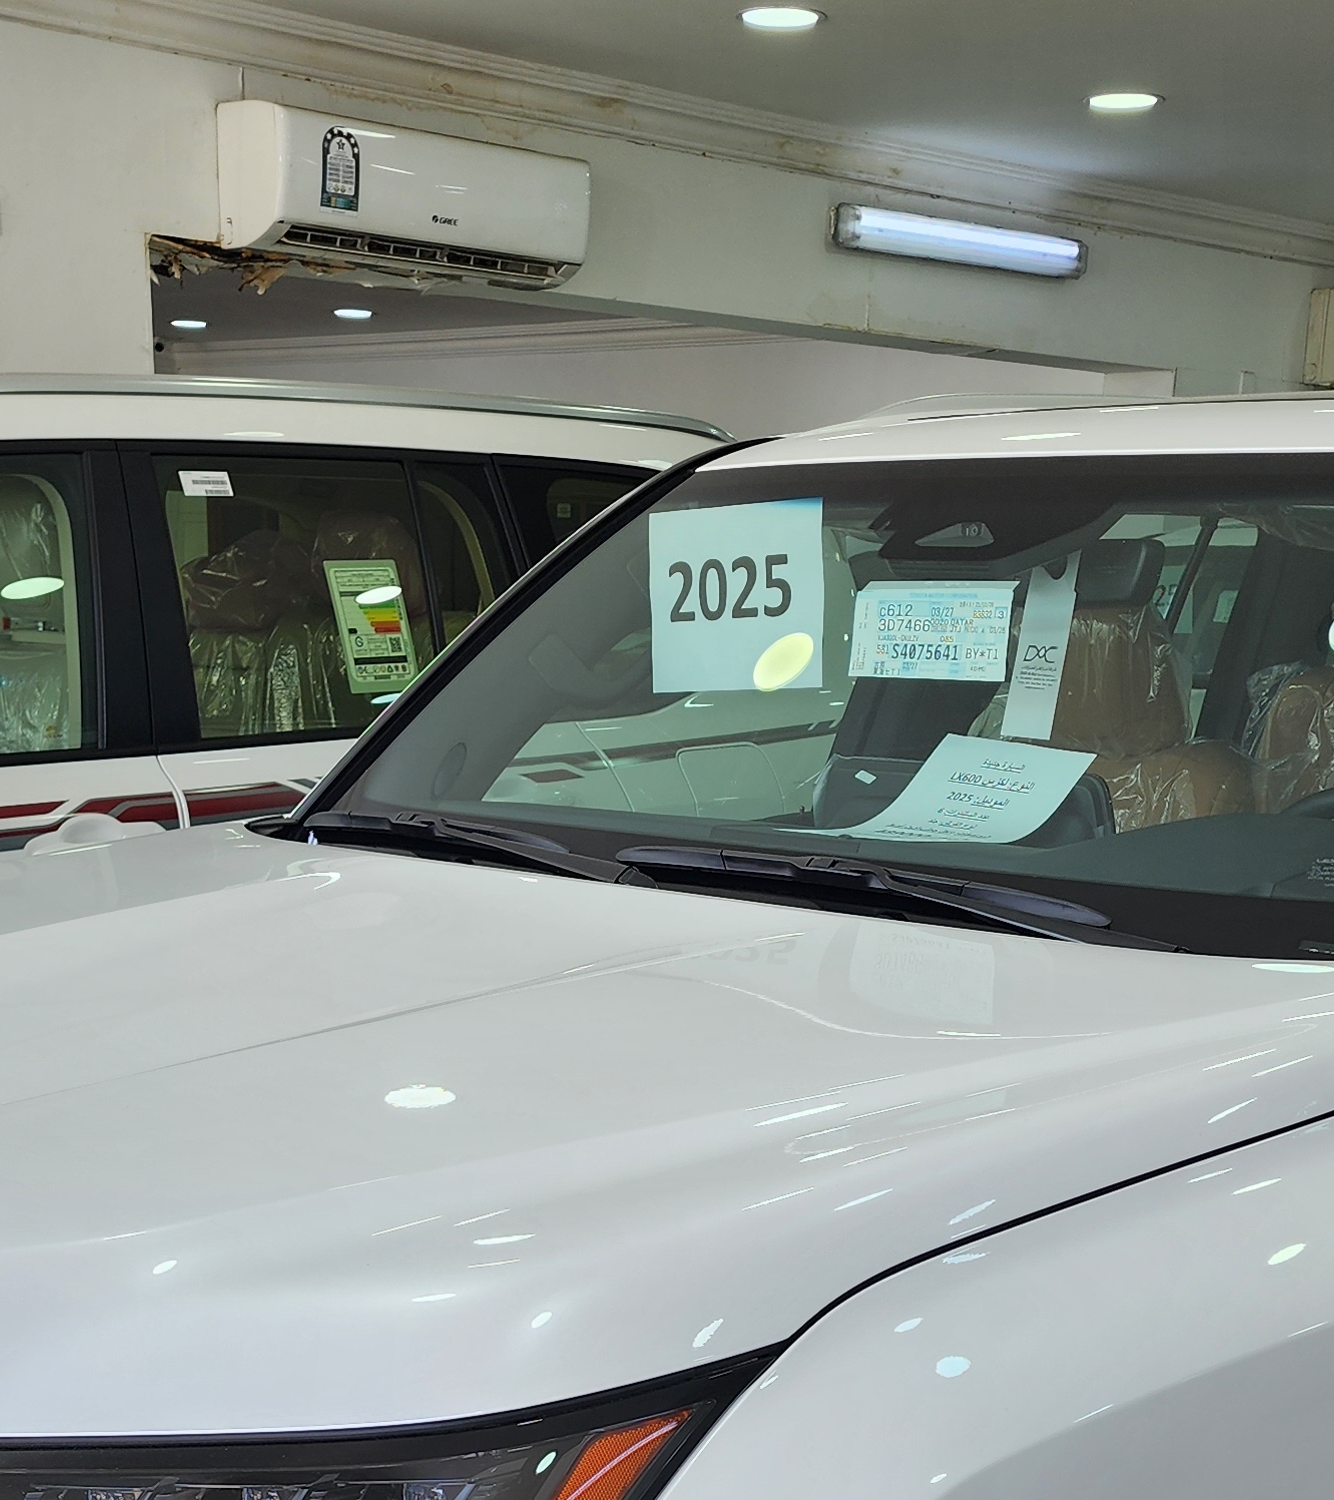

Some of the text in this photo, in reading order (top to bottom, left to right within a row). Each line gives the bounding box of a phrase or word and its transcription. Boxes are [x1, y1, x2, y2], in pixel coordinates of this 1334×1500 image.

[439, 217, 459, 226] GREE
[668, 553, 792, 623] 2025
[878, 618, 931, 632] 3D7466
[891, 643, 959, 661] S4075641
[950, 771, 983, 784] LX600
[946, 791, 974, 803] 2025
